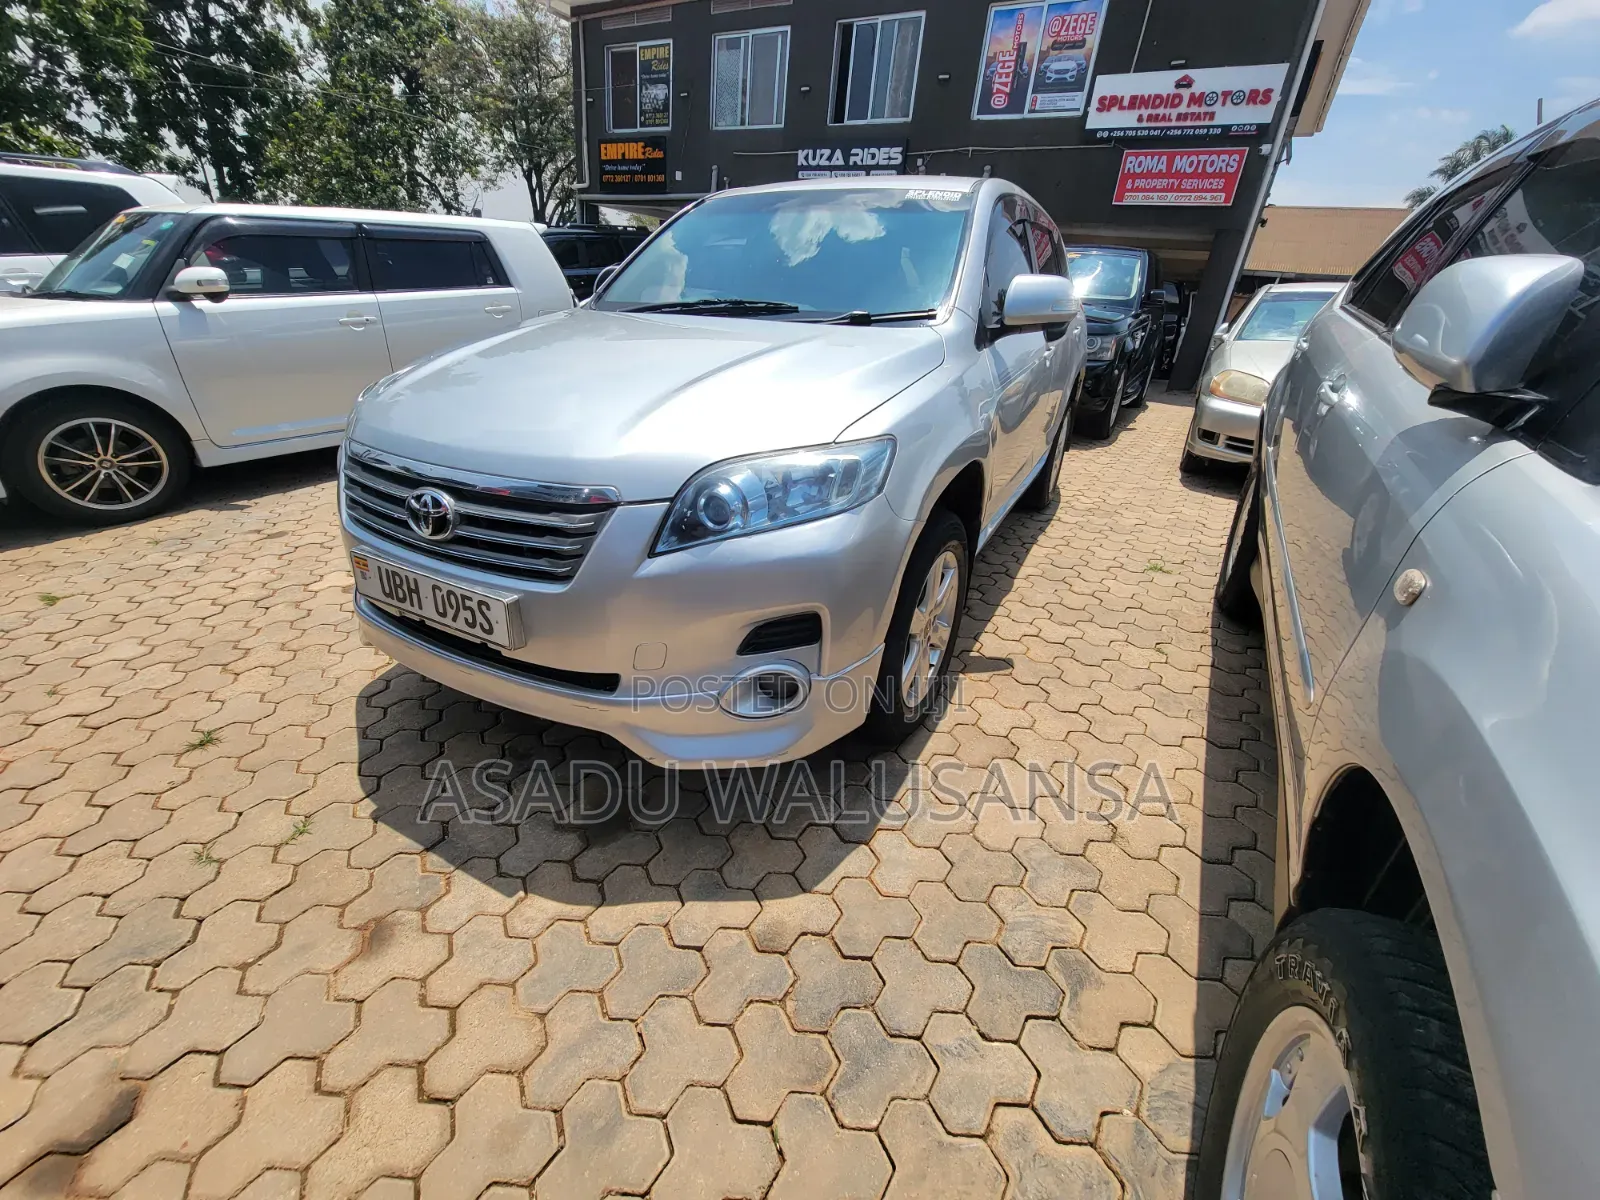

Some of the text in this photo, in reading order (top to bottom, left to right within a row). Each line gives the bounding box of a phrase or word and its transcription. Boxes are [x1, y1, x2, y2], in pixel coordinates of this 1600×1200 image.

[1013, 13, 1024, 49] MOTORS
[1049, 12, 1097, 37] @ZEGE
[640, 46, 669, 60] EMPIRE
[651, 60, 669, 71] Rides
[990, 50, 1018, 108] @ZEGE
[1096, 88, 1275, 112] SPLENDID MOTORS
[1137, 111, 1216, 123] & REAL ESTATE
[1208, 127, 1221, 135] 330
[601, 142, 664, 160] EMPIRE Rides
[797, 147, 903, 166] KUZA RIDES
[1124, 154, 1240, 173] ROMA MOTORS
[1126, 178, 1225, 189] & PROPERTY SERVICES
[377, 565, 494, 636] UBH 095S
